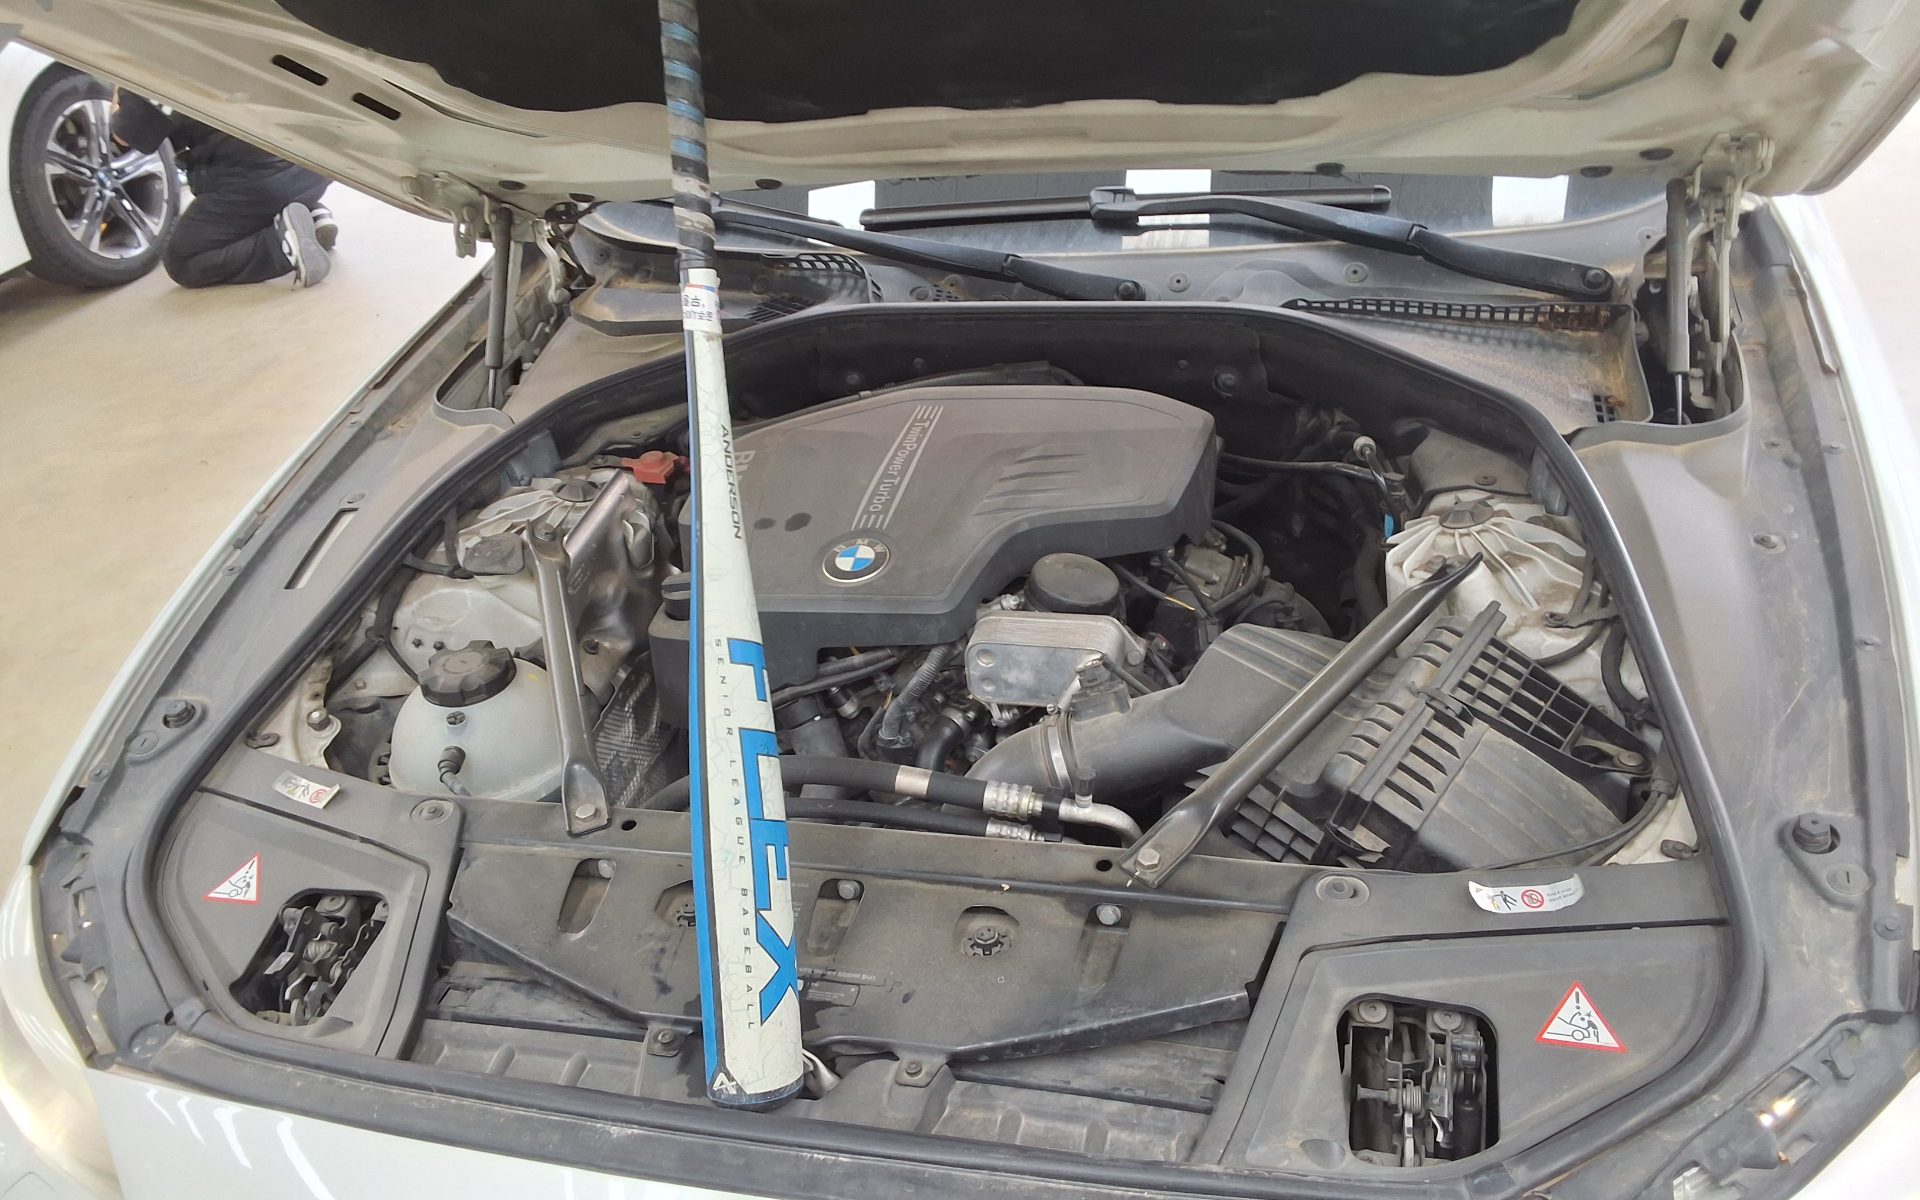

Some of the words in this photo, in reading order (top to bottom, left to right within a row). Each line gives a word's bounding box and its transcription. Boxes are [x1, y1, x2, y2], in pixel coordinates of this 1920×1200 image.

[721, 424, 742, 539] ANDERSON
[888, 420, 930, 476] TwinPower
[869, 476, 900, 512] Turbo
[834, 538, 887, 553] BMW
[714, 638, 734, 736] SENIOR
[729, 759, 746, 864] LEAGUE
[740, 887, 755, 1030] BASEBALL
[727, 637, 798, 1027] FLEX
